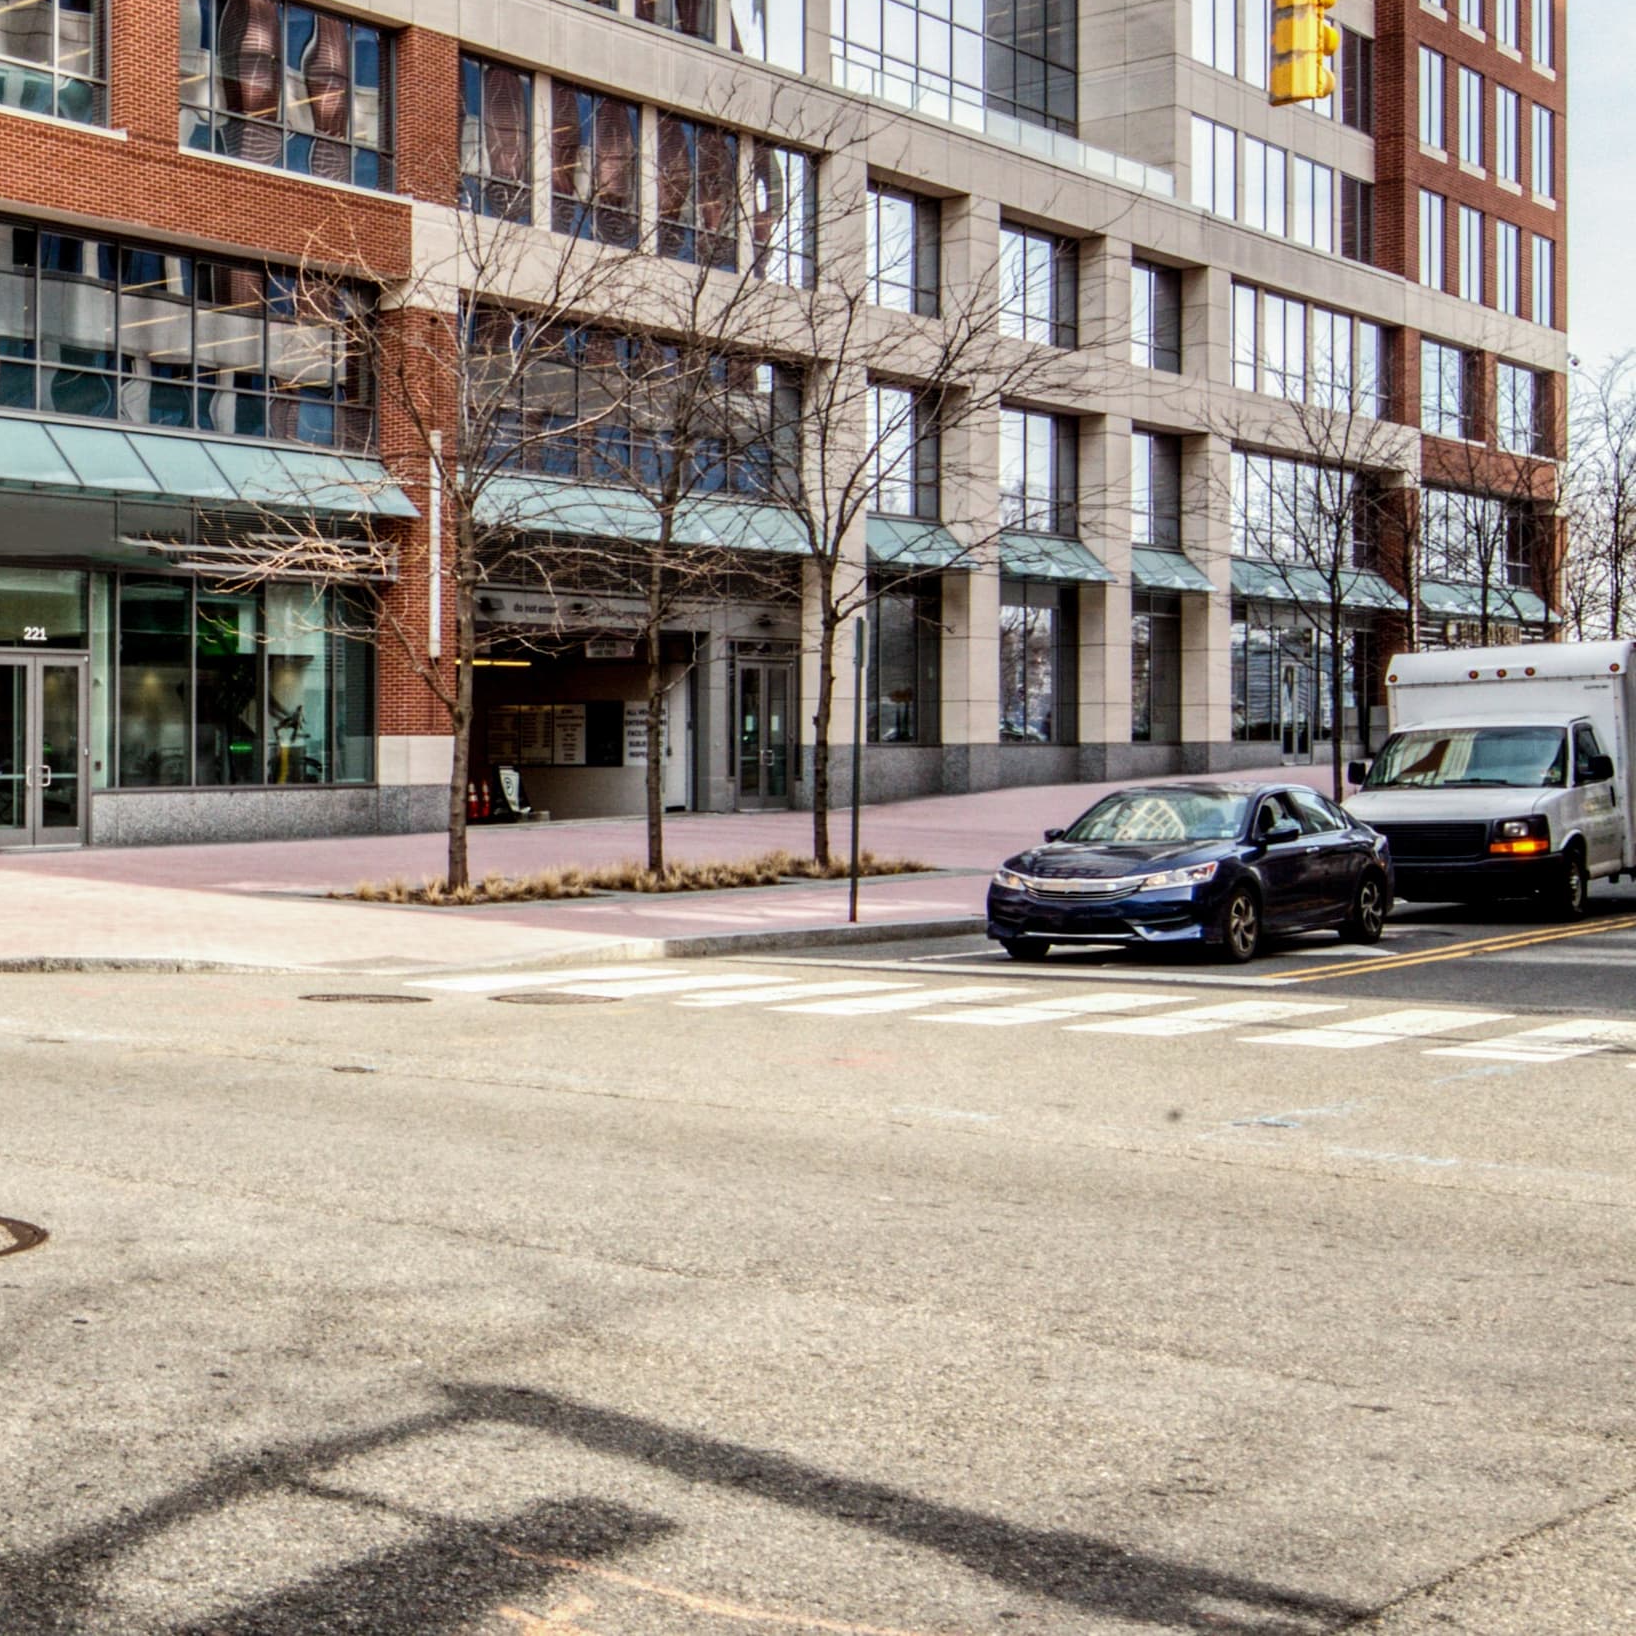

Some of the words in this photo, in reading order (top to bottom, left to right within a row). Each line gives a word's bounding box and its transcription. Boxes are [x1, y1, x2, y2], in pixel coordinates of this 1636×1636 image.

[513, 602, 523, 613] do
[525, 604, 538, 614] not
[24, 626, 47, 640] 221
